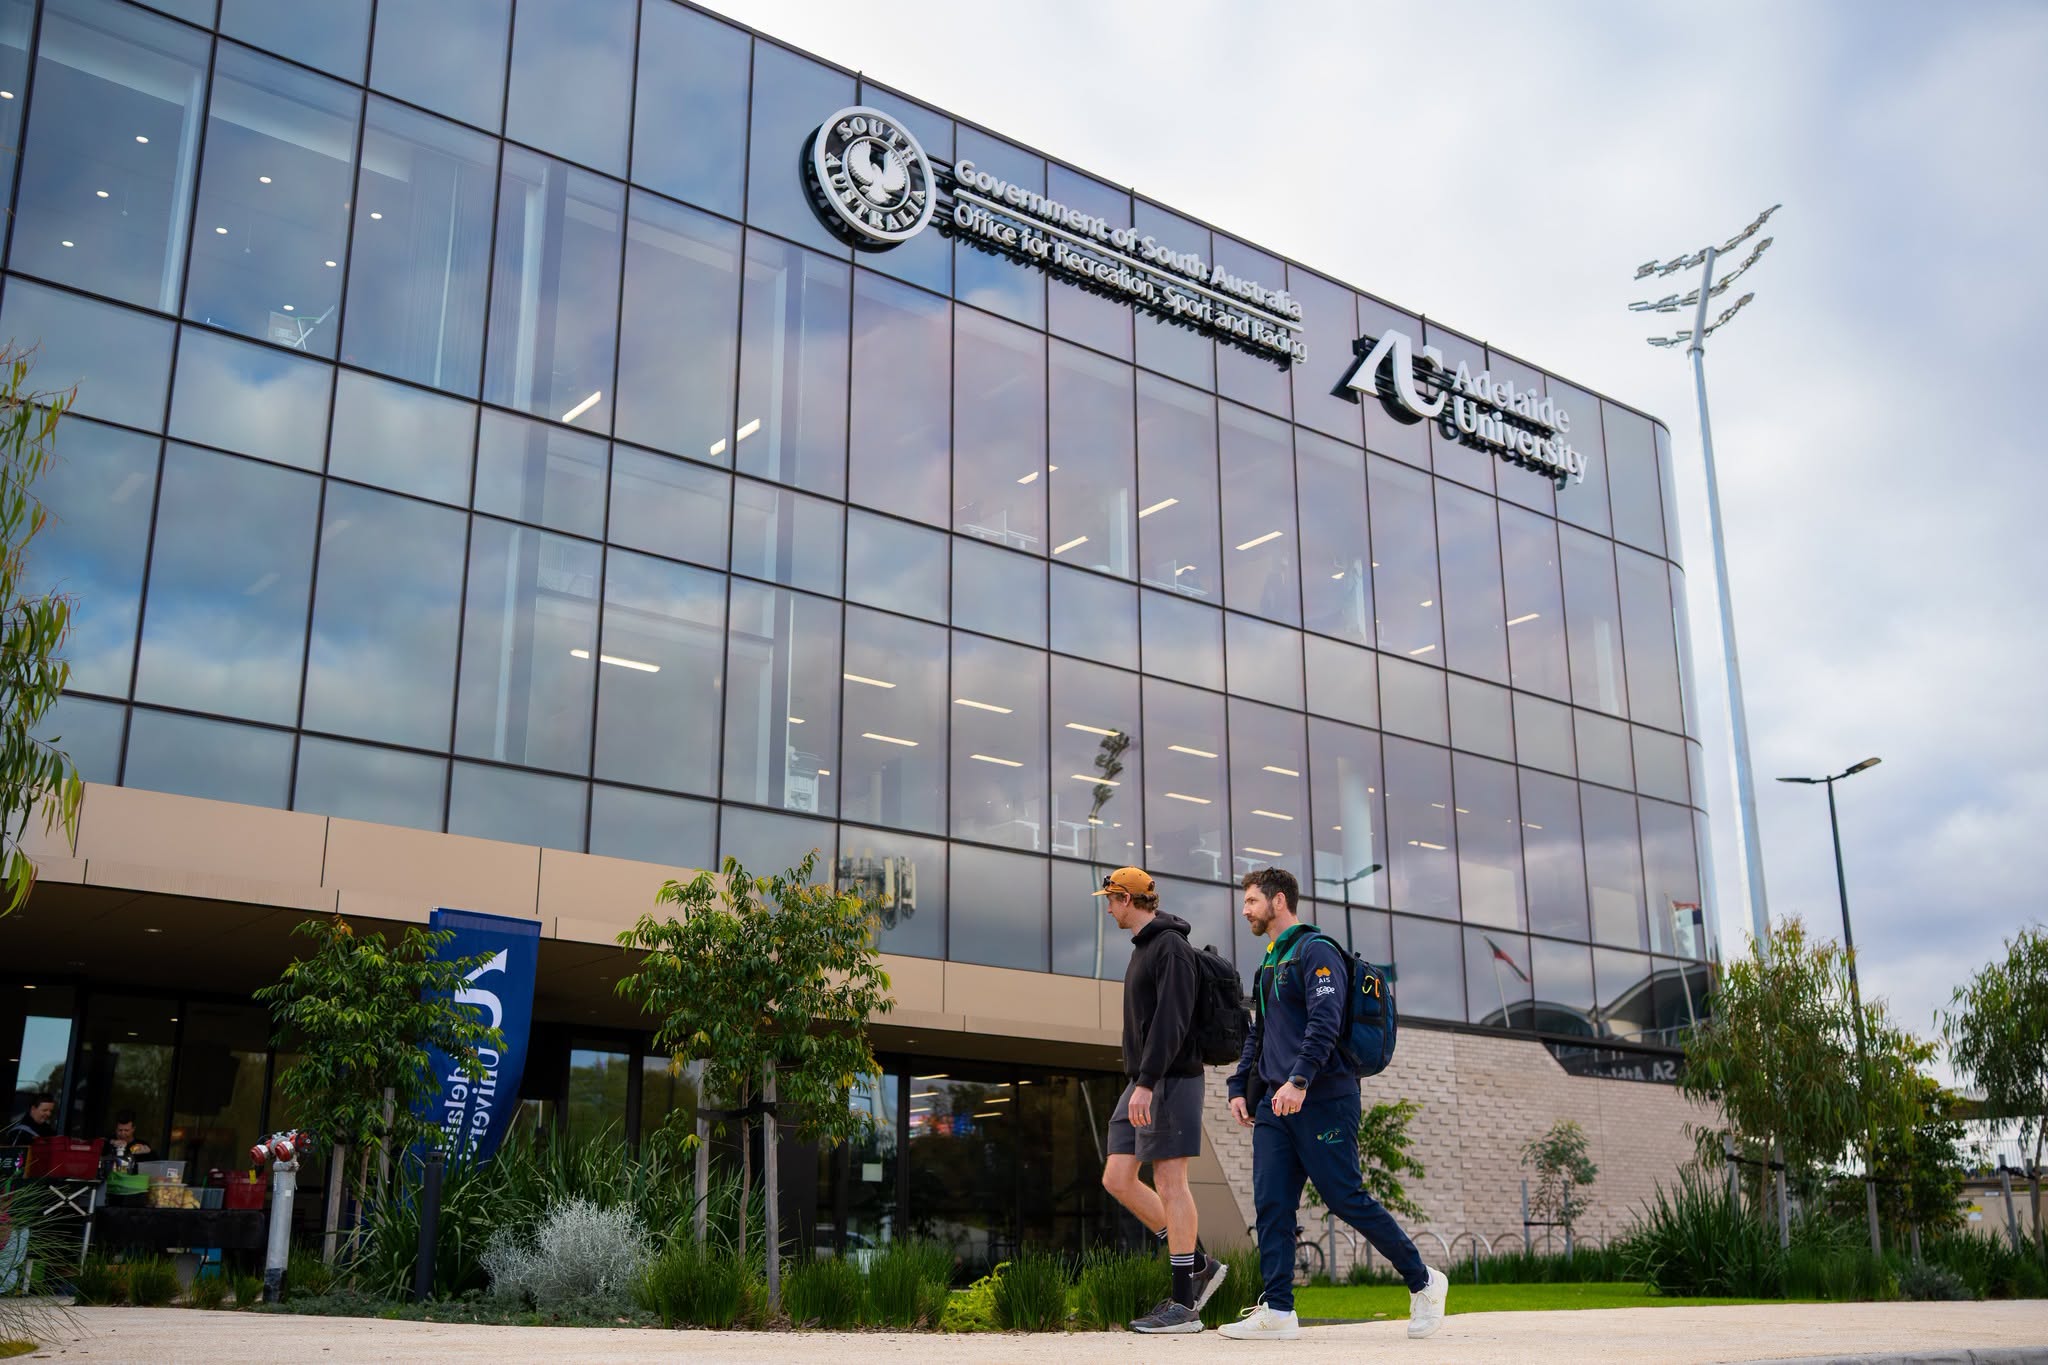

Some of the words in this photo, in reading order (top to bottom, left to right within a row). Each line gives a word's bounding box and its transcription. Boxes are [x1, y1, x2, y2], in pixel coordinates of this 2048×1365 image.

[836, 116, 918, 167] SOUTH
[825, 152, 926, 232] AUSTRALIA
[954, 159, 1109, 242] Government
[1111, 227, 1138, 251] of
[1141, 235, 1208, 281] South
[1210, 264, 1303, 320] Australia
[954, 204, 1017, 246] Office
[1019, 227, 1052, 260] for
[1054, 242, 1160, 305] Recreation,
[1163, 286, 1213, 323] Sport
[1214, 310, 1250, 338] and
[1251, 319, 1308, 365] Racing
[1452, 359, 1570, 434] Adelaide
[1453, 394, 1588, 486] University
